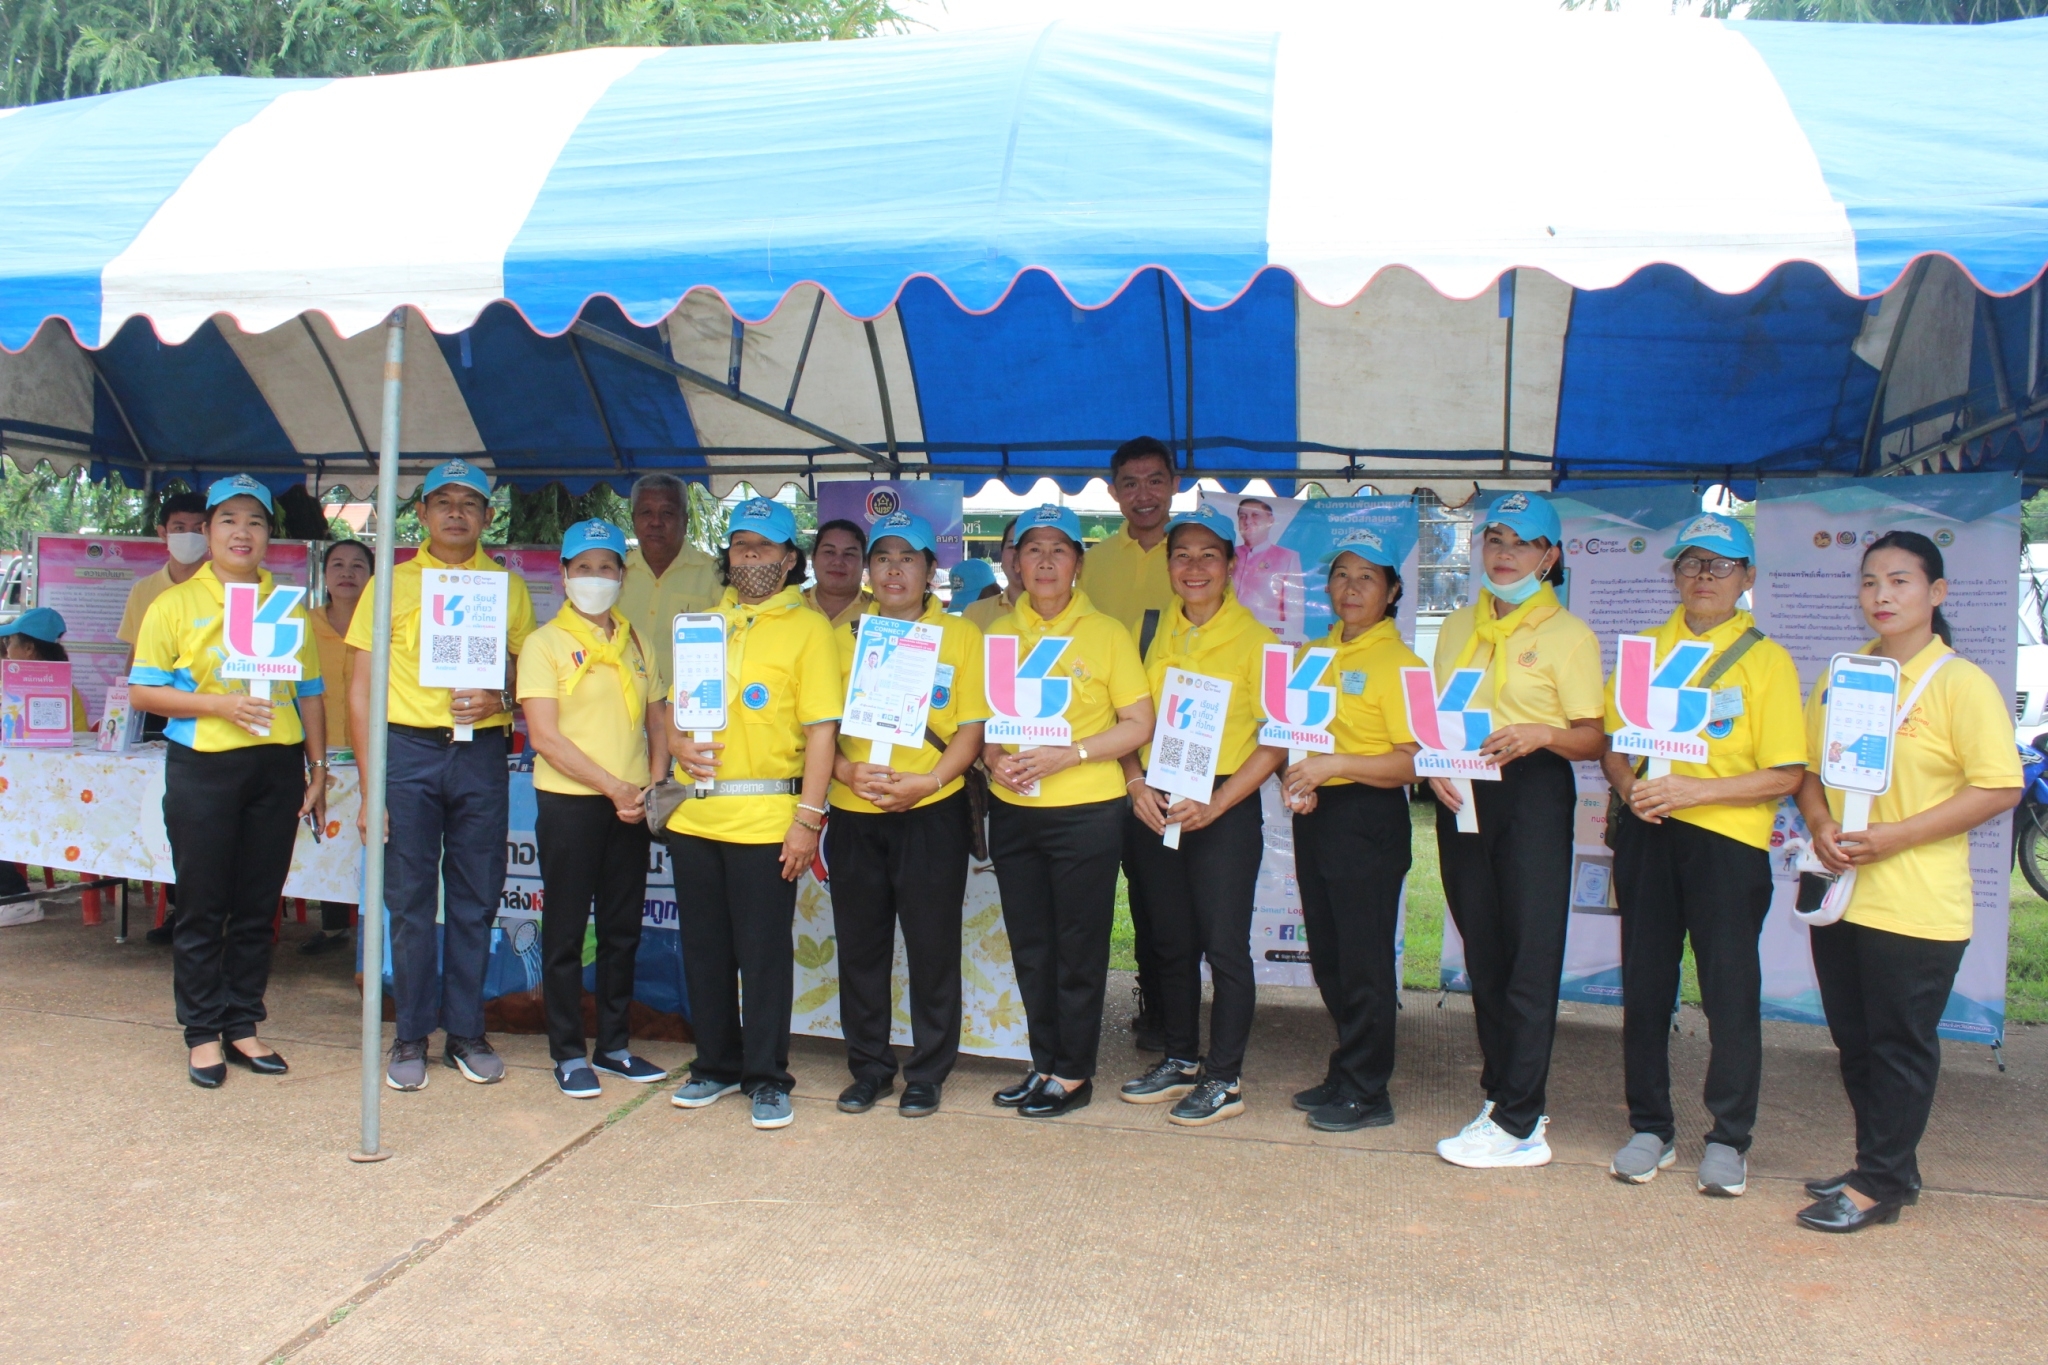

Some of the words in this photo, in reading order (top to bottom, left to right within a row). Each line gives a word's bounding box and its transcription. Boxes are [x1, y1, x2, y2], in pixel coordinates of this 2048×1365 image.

[1314, 500, 1411, 511] สำนักงานพัฒนาชุมชน
[1328, 513, 1398, 523] จังหวัดสกลนคร
[935, 534, 959, 543] ลนคร
[84, 569, 125, 578] ความเป็นมา
[1768, 568, 1851, 580] กลุ่มออมทรัพย์เพื่อการผลิต
[473, 594, 497, 604] เรียนรู้
[473, 602, 492, 612] เที่ยว
[472, 612, 497, 622] ทั่วไทย
[870, 618, 890, 627] CLICK
[874, 625, 906, 636] CONNECT
[226, 659, 297, 677] คลิกชุมชน
[988, 721, 1068, 740] คลิกชุมชน
[1264, 725, 1329, 745] คลิกชุมชน
[1617, 732, 1704, 756] คลิกชุมชน
[1418, 754, 1497, 773] คลิกชุมชน
[719, 782, 764, 795] Supreme
[1260, 906, 1286, 914] Smart
[1288, 907, 1304, 917] Log
